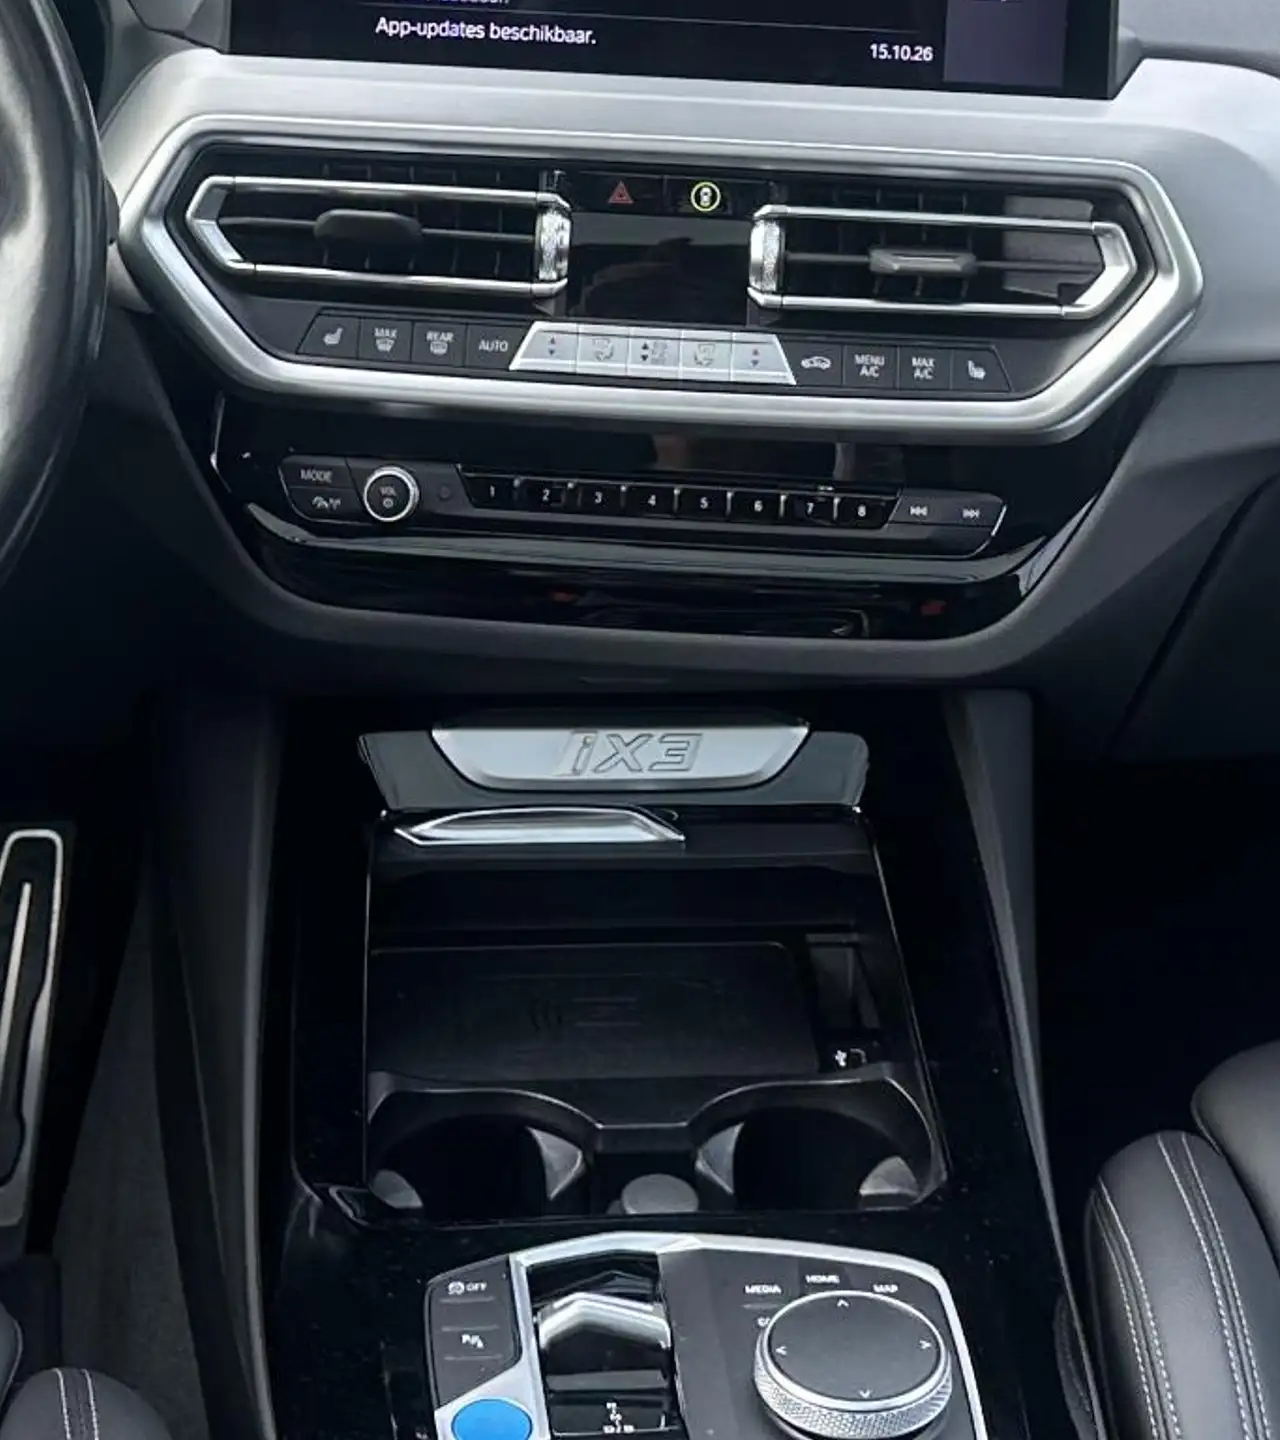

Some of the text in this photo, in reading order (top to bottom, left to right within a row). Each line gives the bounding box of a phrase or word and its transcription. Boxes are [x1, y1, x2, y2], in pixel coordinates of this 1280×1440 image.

[376, 16, 597, 45] App-updates beschikbaar.
[869, 42, 934, 62] 15.10.26
[426, 330, 454, 342] REAR
[478, 339, 509, 352] AUTO
[854, 354, 885, 366] MENU
[911, 356, 936, 367] MAX
[859, 365, 880, 378] A/C
[913, 367, 933, 380] A/C
[300, 468, 332, 483] MODE
[647, 493, 657, 507] 4
[700, 496, 709, 510] 5
[753, 499, 763, 512] 6
[858, 504, 867, 518] 8
[568, 731, 704, 774] iX3
[805, 1274, 840, 1285] HOME
[745, 1284, 782, 1294] MEDIA
[873, 1283, 898, 1294] MAP
